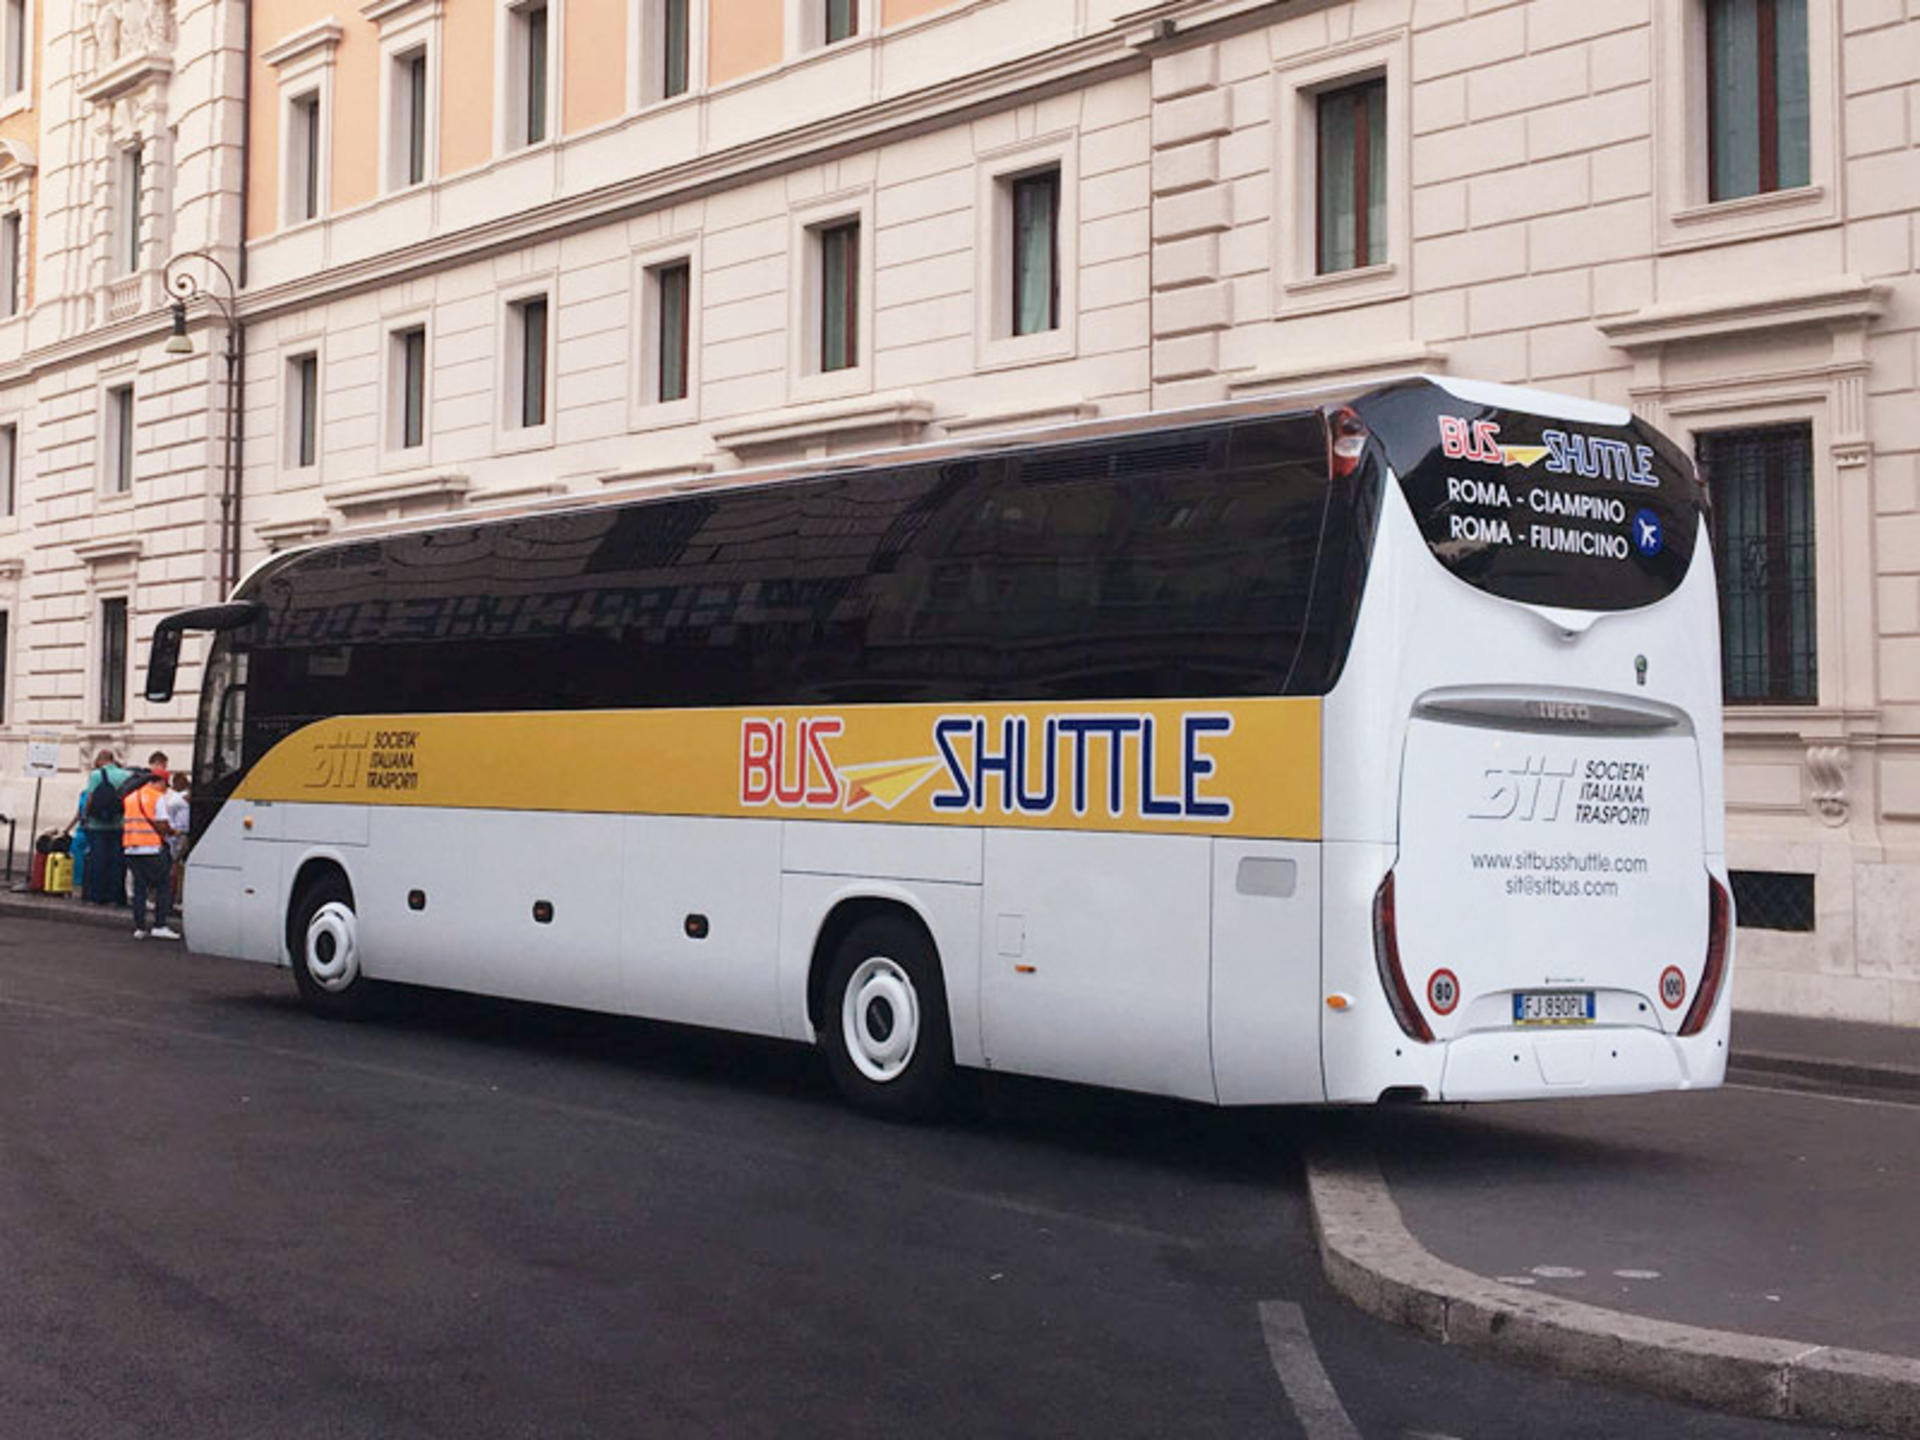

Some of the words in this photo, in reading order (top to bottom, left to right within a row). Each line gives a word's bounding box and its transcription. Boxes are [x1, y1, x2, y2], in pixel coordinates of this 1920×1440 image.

[1439, 415, 1501, 463] BUS
[1543, 429, 1659, 487] SHUTTLE
[1448, 477, 1510, 507] ROMA
[1529, 489, 1625, 523] CIAMPINO
[1450, 515, 1512, 544] ROMA
[1530, 525, 1628, 560] FIUMICINO
[1539, 702, 1589, 719] IVECO
[370, 752, 414, 769] ITALIANA
[741, 717, 844, 807] BUS
[932, 711, 1232, 818] SHUTTLE
[367, 772, 418, 789] TRASPORTI
[1579, 783, 1644, 802] ITALIANA
[1575, 804, 1649, 825] TRASPORTI
[1471, 852, 1648, 872] www.sitbusshuttle.com
[1506, 875, 1618, 897] sit@sitbus.com
[1434, 981, 1452, 1000] 80
